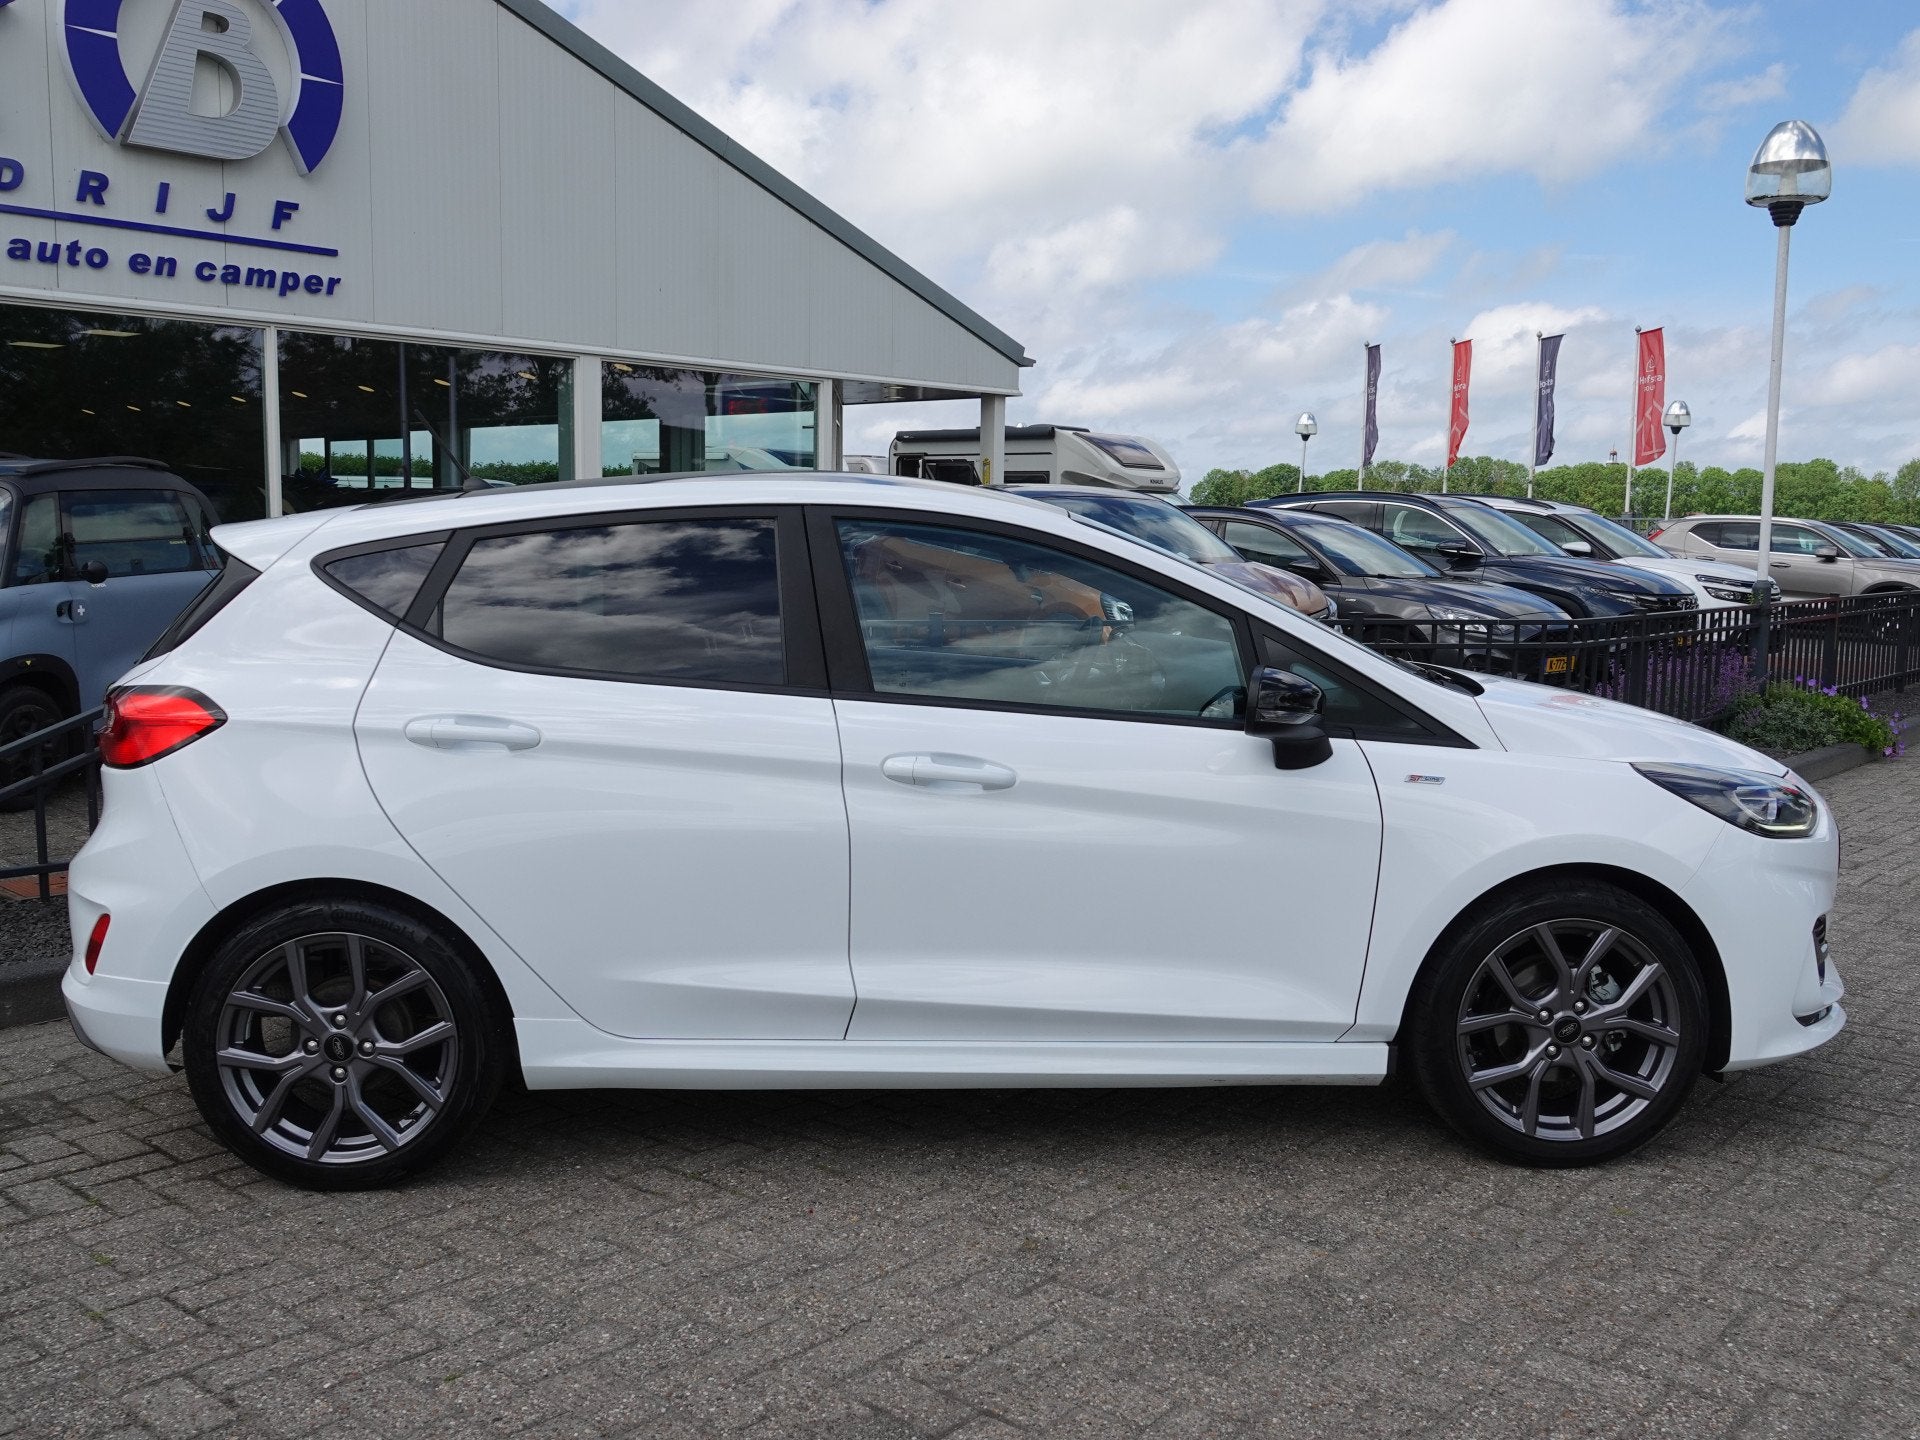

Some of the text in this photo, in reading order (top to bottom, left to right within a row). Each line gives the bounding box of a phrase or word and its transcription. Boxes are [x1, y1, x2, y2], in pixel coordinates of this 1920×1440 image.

[7, 237, 342, 297] auto en camper
